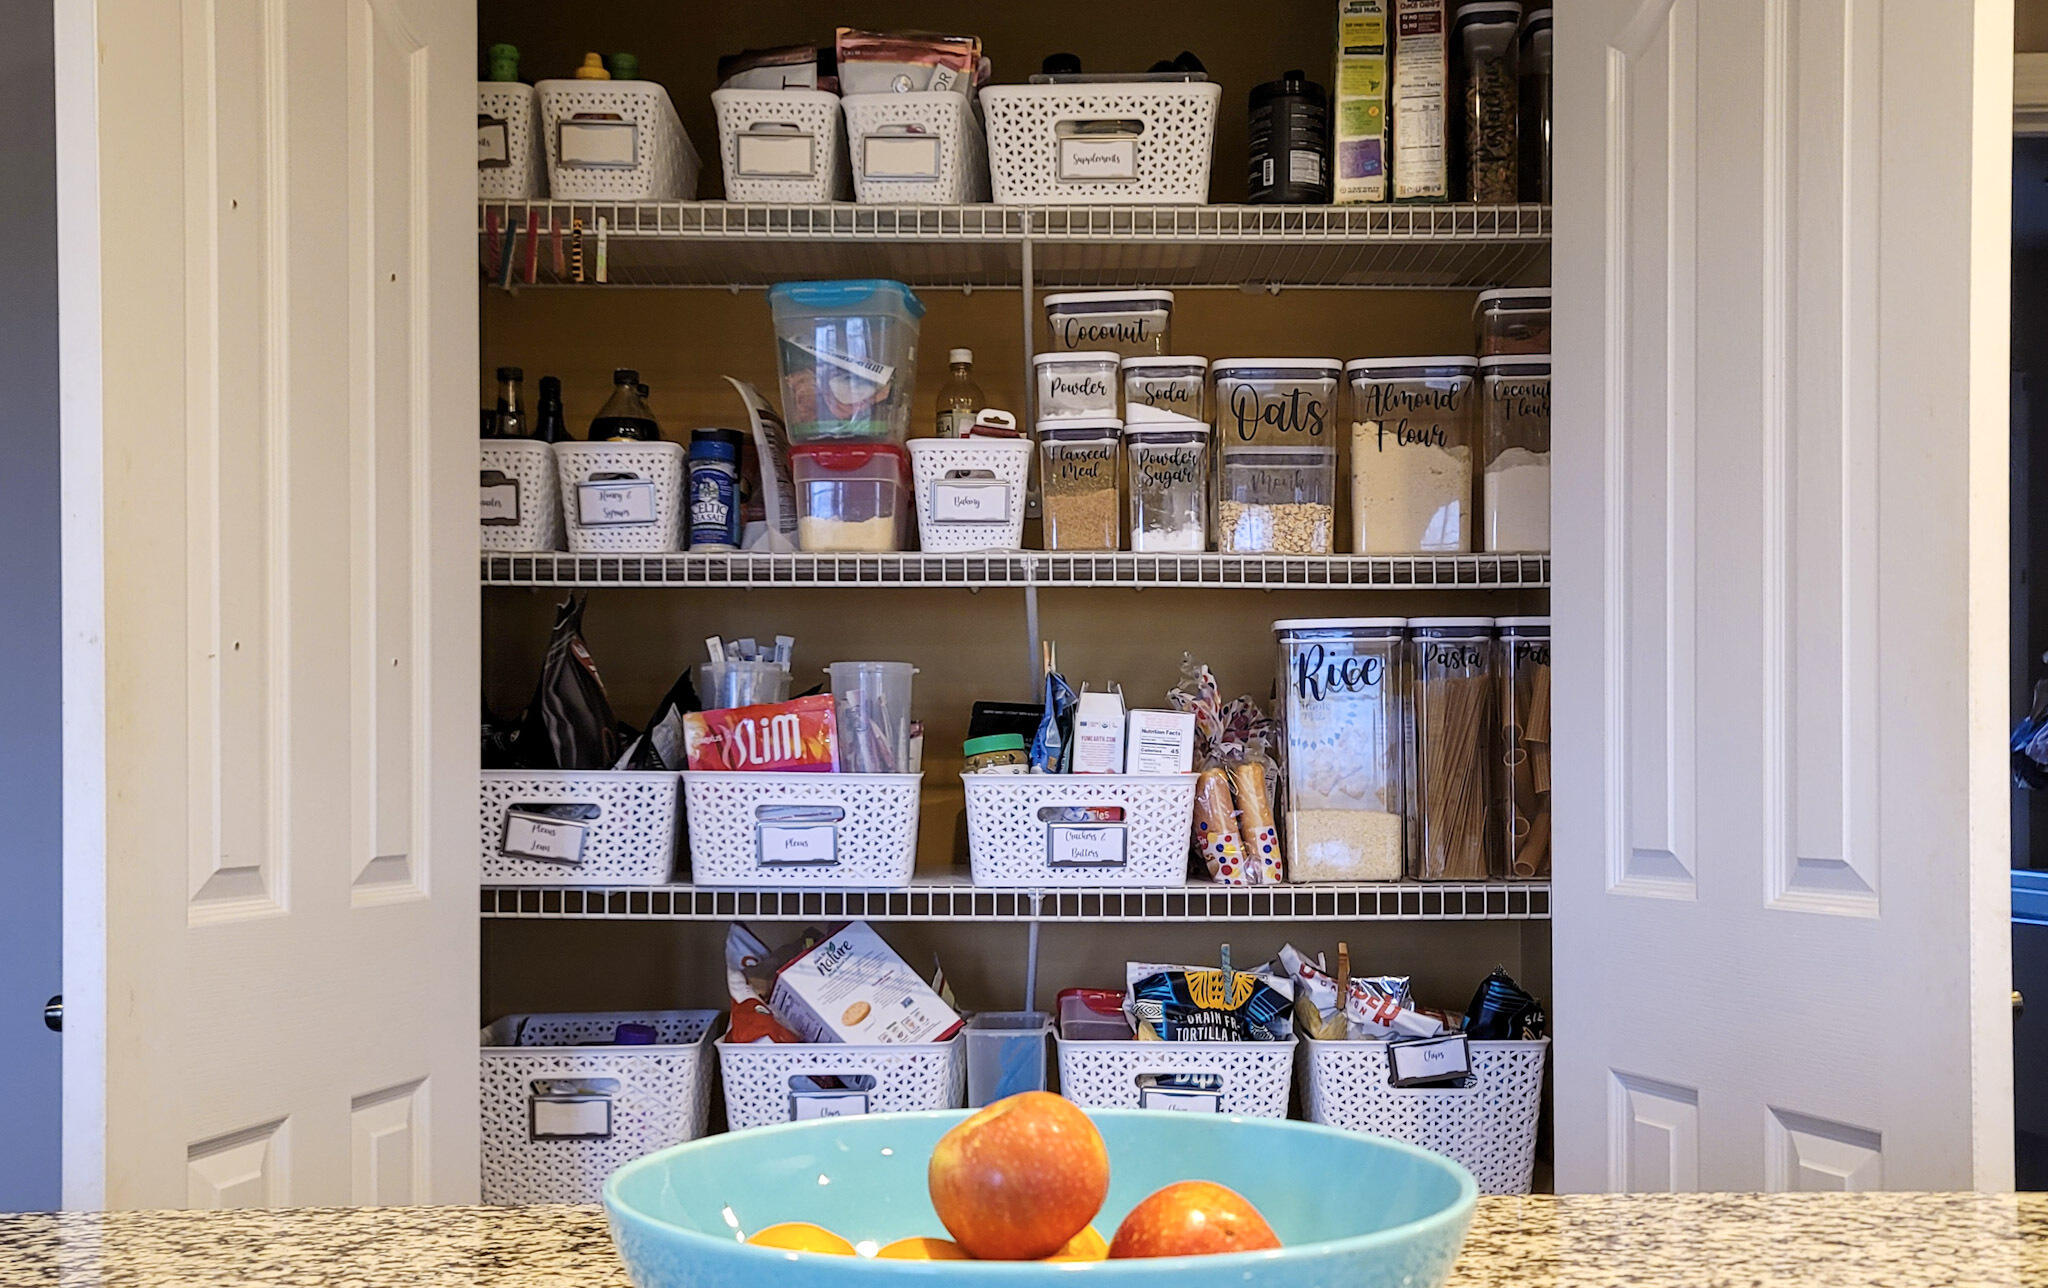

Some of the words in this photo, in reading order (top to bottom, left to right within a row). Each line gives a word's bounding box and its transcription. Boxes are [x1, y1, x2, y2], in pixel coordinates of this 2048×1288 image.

[1073, 153, 1121, 166] Supplements
[1064, 317, 1151, 349] Coconut
[1050, 377, 1108, 399] Powder
[1144, 381, 1190, 406] Soda
[1364, 383, 1461, 417] Almond
[1231, 383, 1329, 441] Oats
[1357, 417, 1448, 453] Flour
[1048, 445, 1111, 465] Flaxseed
[1137, 448, 1199, 468] Powder
[1061, 461, 1101, 481] Meal
[1143, 465, 1195, 489] Sugar
[1424, 643, 1484, 669] Pasta
[1516, 641, 1550, 670] Pas
[1299, 644, 1384, 702] Rice
[1175, 1026, 1228, 1042] TORTILLA
